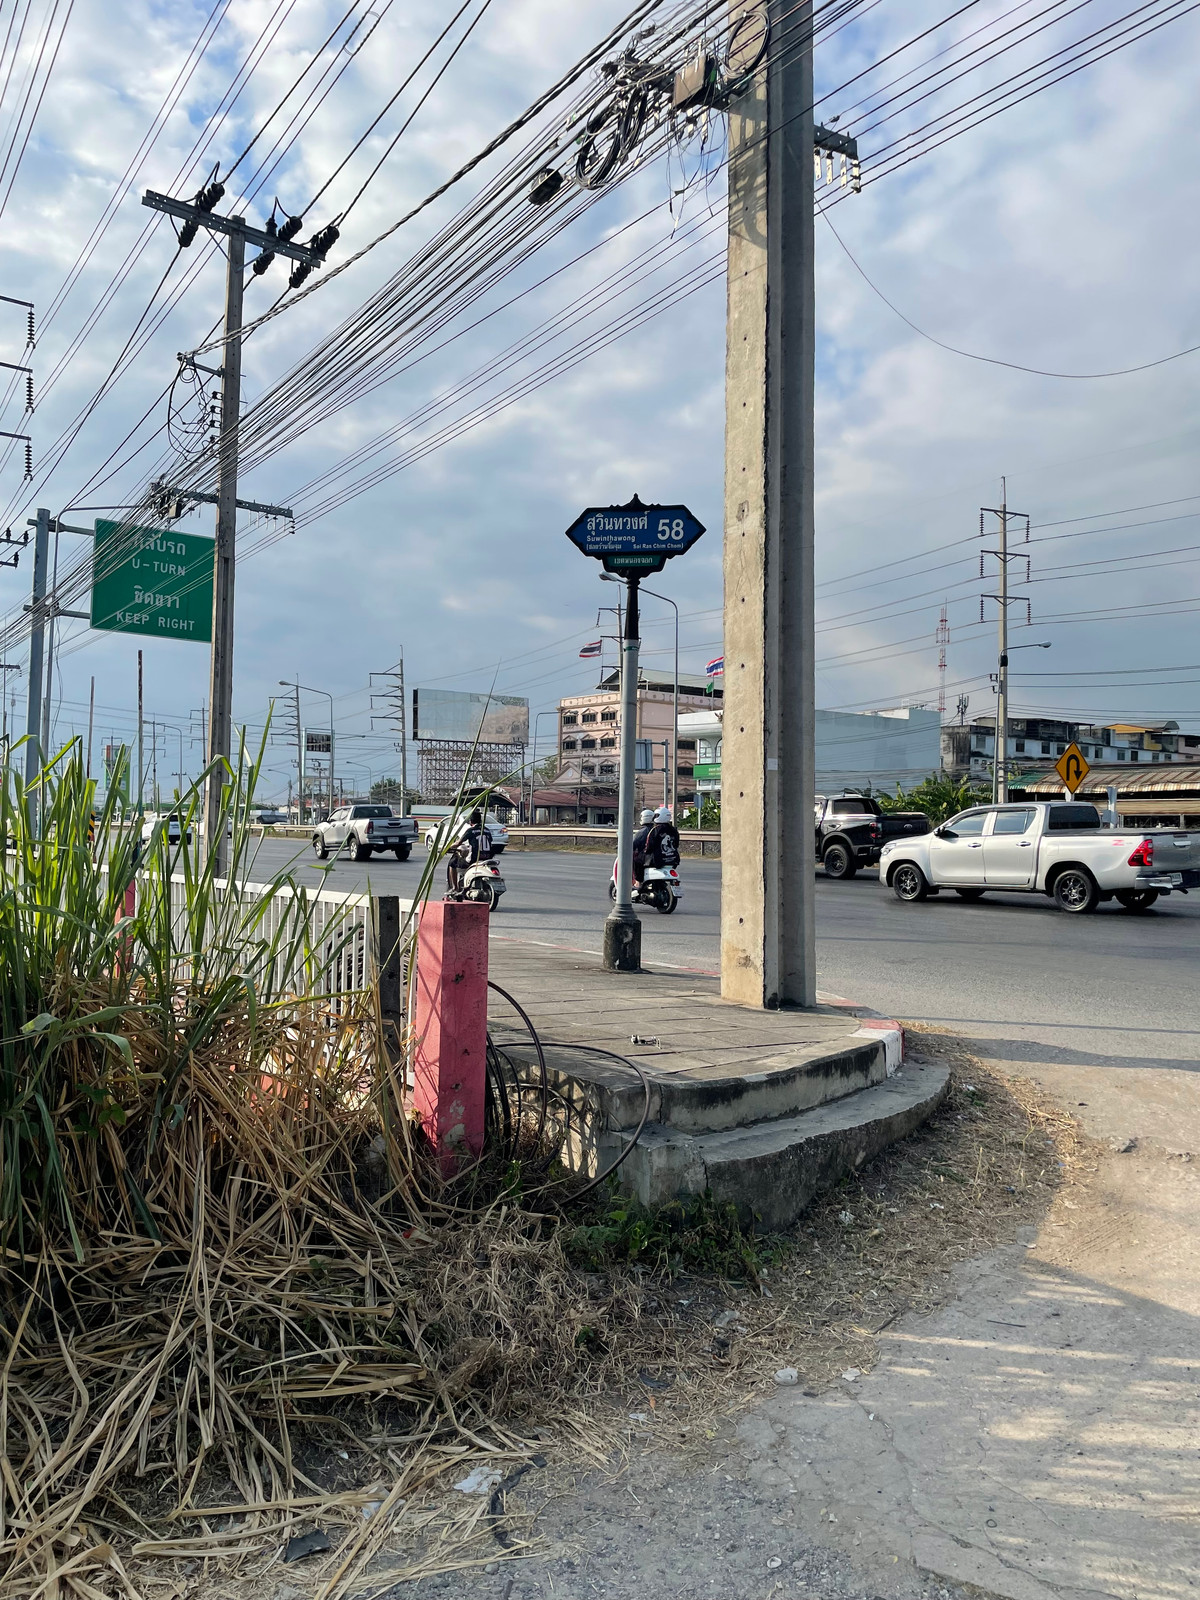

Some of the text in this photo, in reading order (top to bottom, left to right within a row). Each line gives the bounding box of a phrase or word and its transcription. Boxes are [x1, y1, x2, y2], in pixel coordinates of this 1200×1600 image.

[587, 511, 684, 540] สุวินทวงศ์ 58
[587, 535, 636, 543] Suwinthawong
[132, 558, 186, 576] U-TURN
[133, 585, 180, 609] ชิดขวา
[116, 611, 195, 631] KEEP RIGHT
